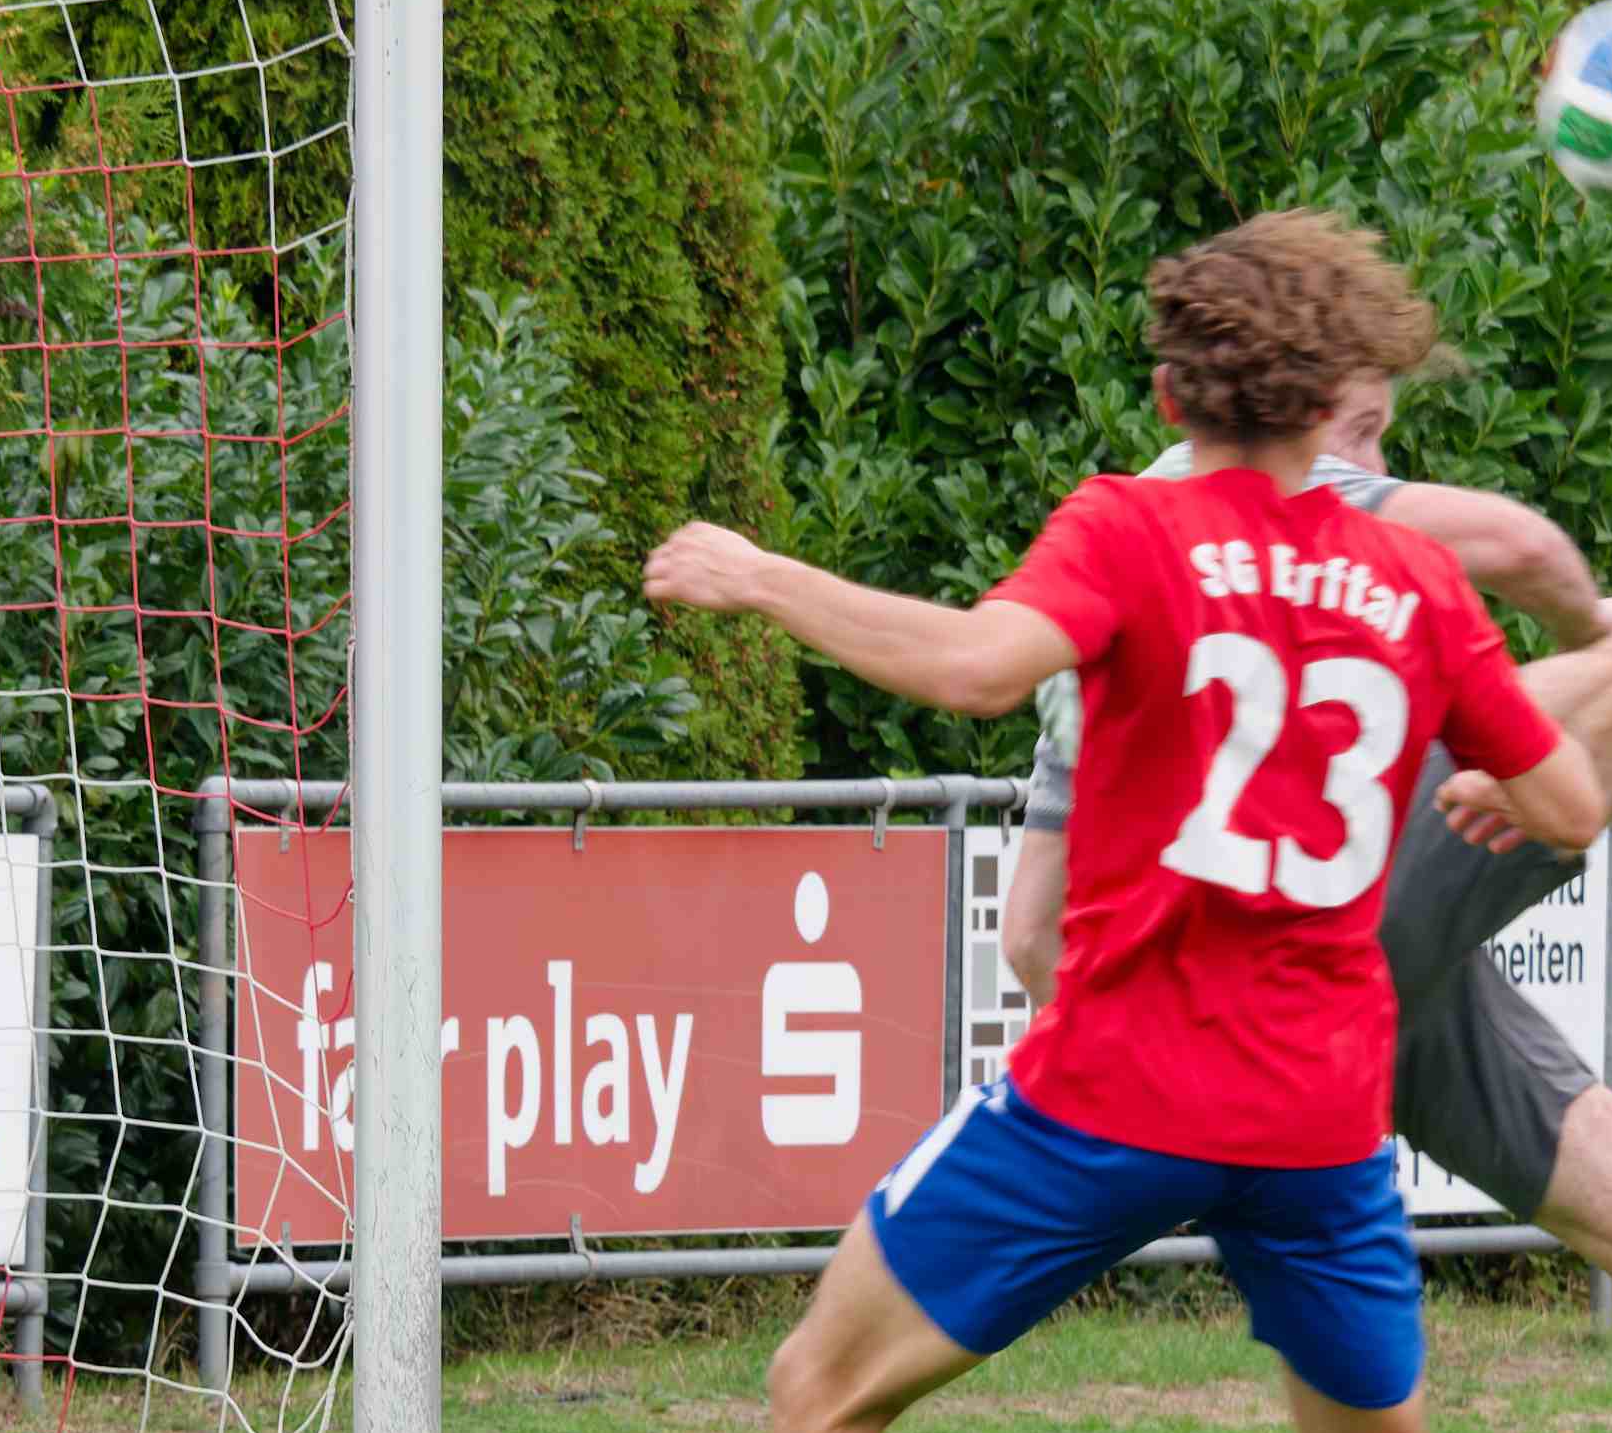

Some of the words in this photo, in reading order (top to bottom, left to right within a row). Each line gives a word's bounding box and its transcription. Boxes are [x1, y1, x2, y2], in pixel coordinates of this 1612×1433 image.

[1189, 539, 1261, 597] SG
[1268, 543, 1420, 642] Erftal
[1160, 633, 1410, 909] 23
[487, 960, 694, 1197] play
